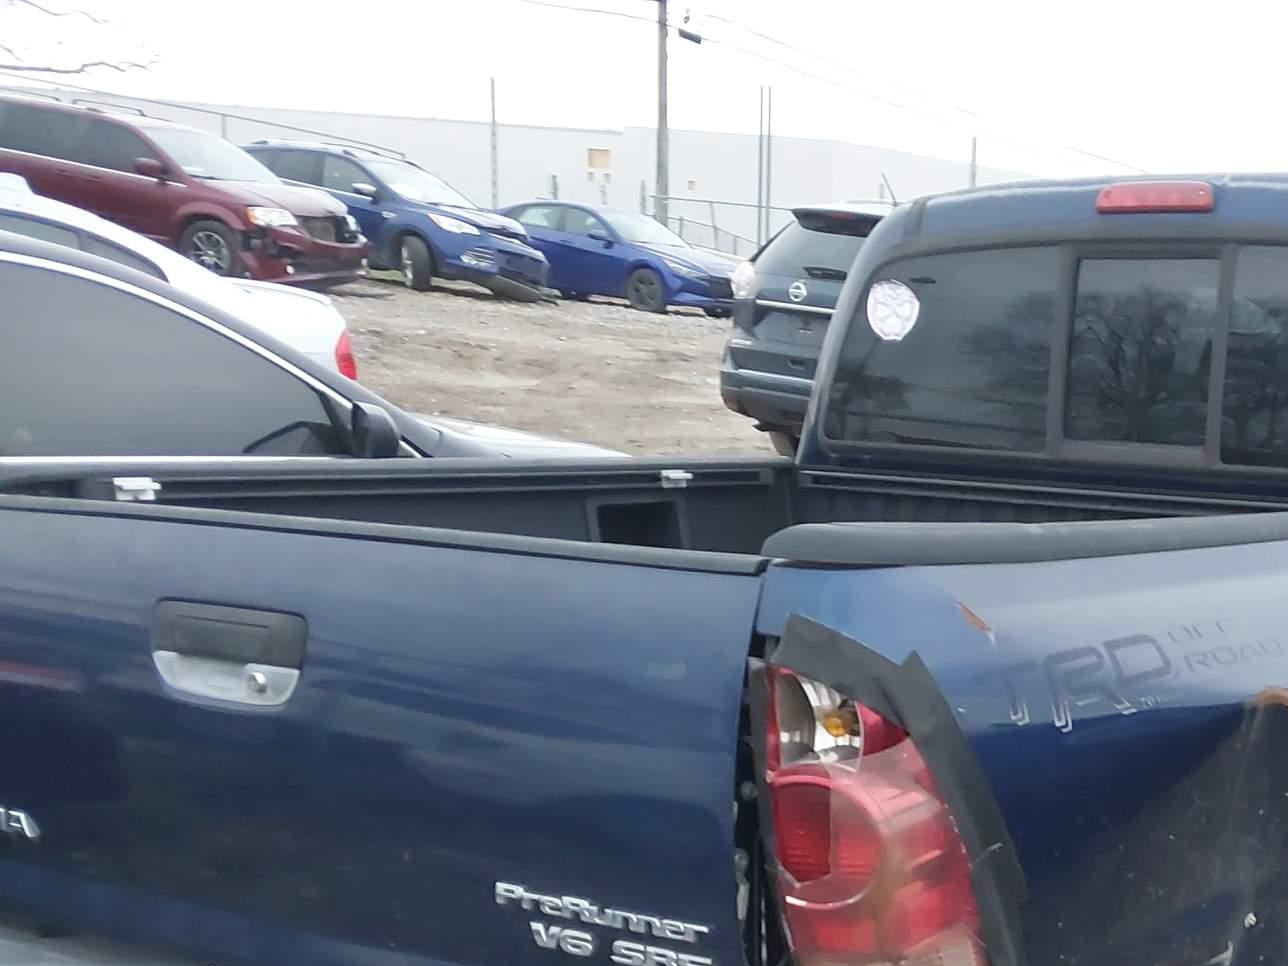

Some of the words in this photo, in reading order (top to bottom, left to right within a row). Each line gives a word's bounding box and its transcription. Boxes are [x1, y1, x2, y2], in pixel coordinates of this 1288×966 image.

[1183, 638, 1285, 673] ROAD
[1001, 633, 1174, 732] TRD
[495, 881, 709, 943] PreRunner
[529, 921, 594, 957] V6
